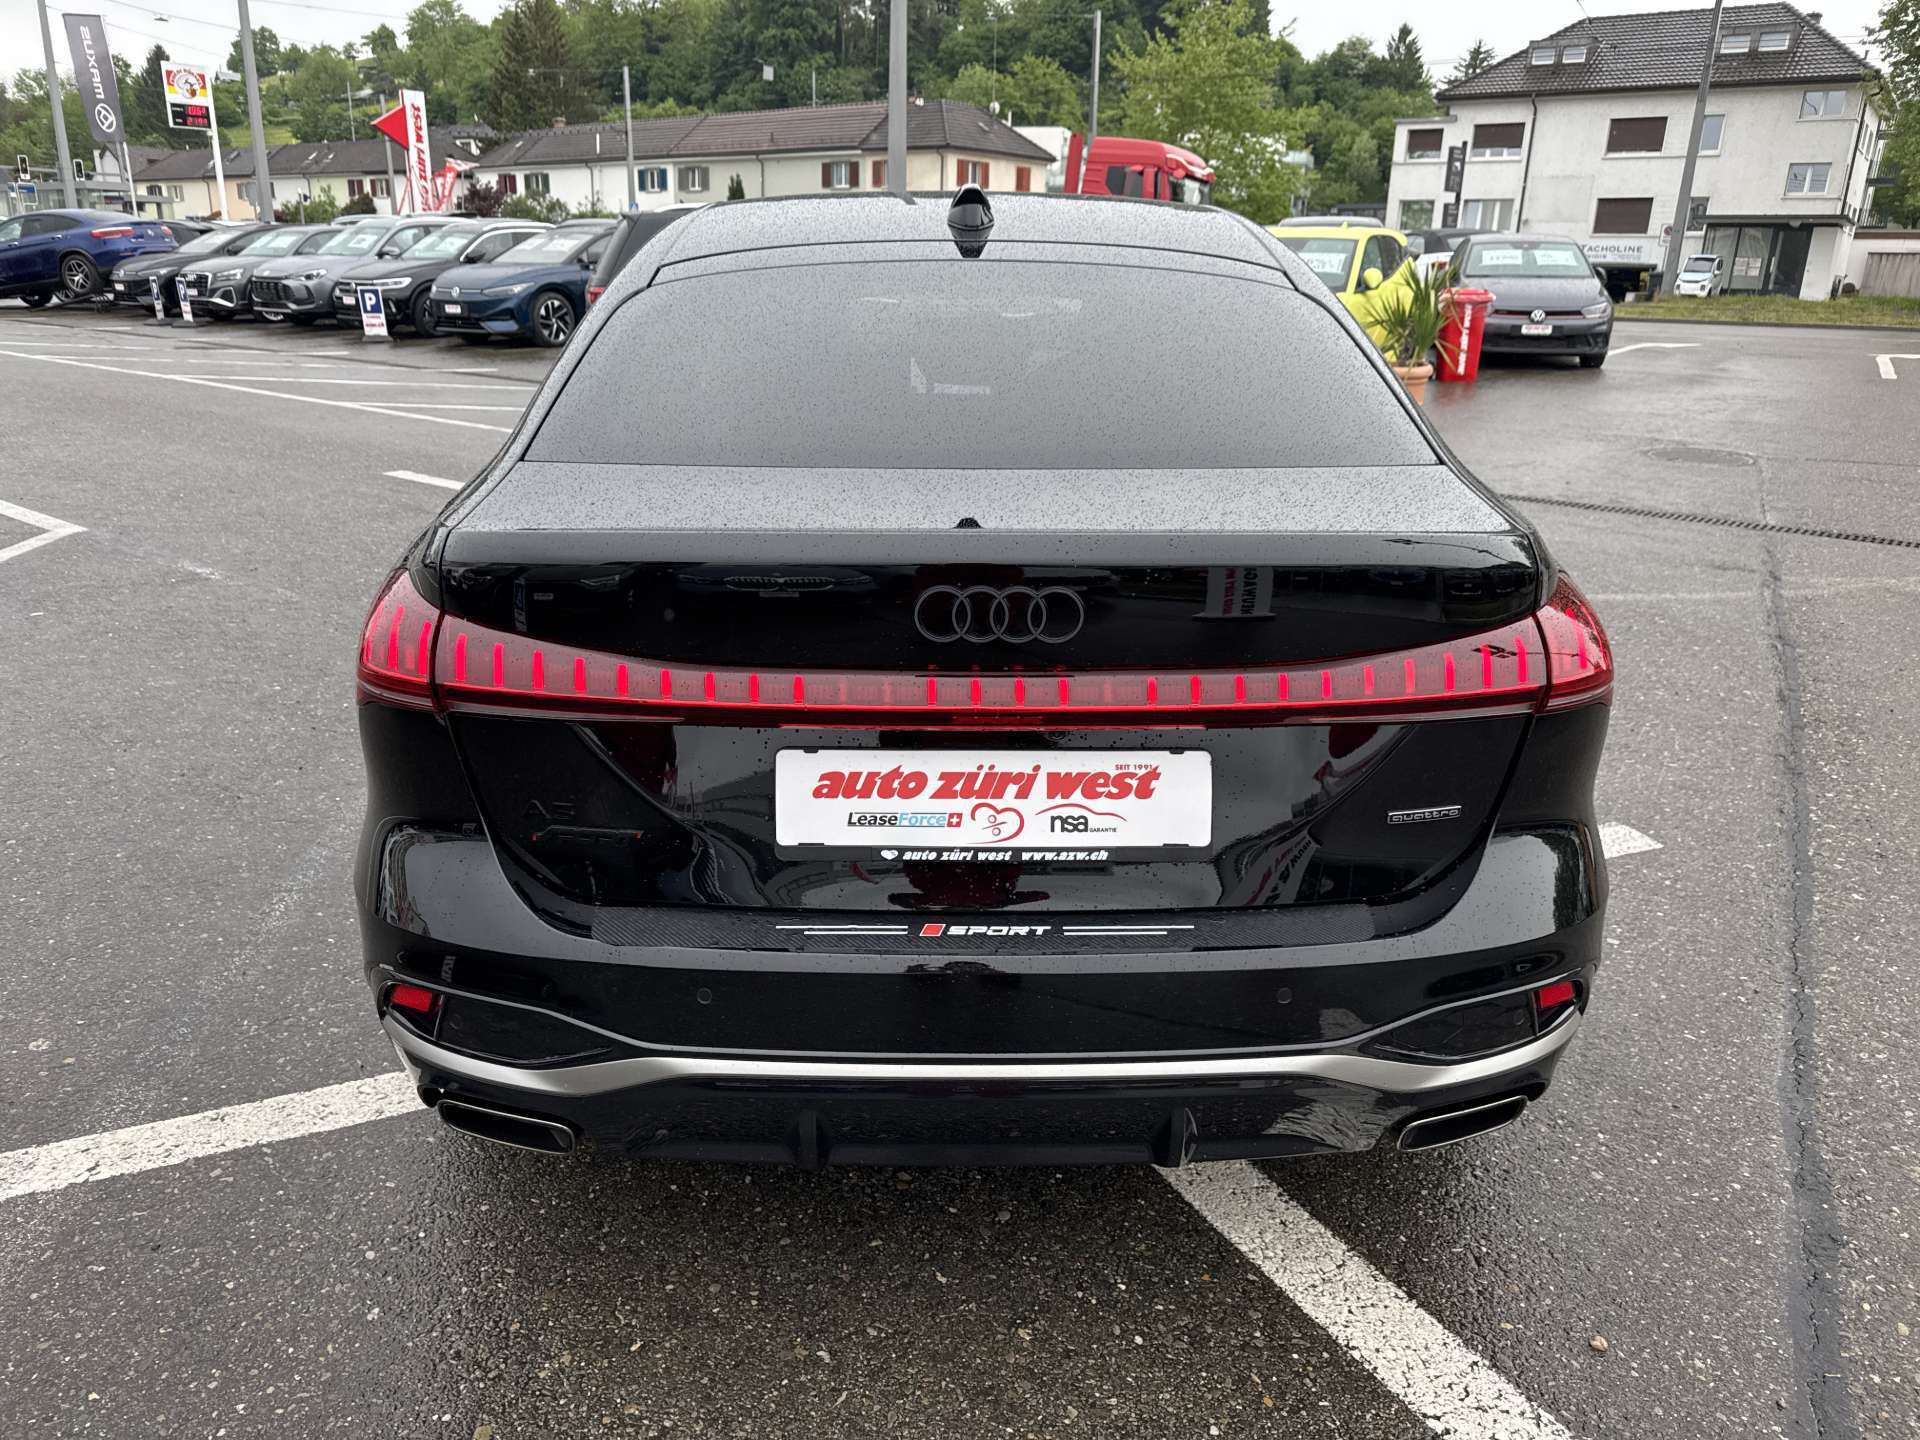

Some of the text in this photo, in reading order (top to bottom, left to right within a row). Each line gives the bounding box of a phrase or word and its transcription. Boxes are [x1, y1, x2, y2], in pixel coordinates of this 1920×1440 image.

[364, 292, 376, 311] P
[812, 764, 1162, 800] auto züri west
[848, 812, 947, 826] LeaseForce
[1392, 809, 1459, 822] quattro
[1050, 815, 1089, 833] nsa
[902, 850, 1109, 861] auto züri west www.azw.ch
[946, 925, 1052, 936] SPORT
